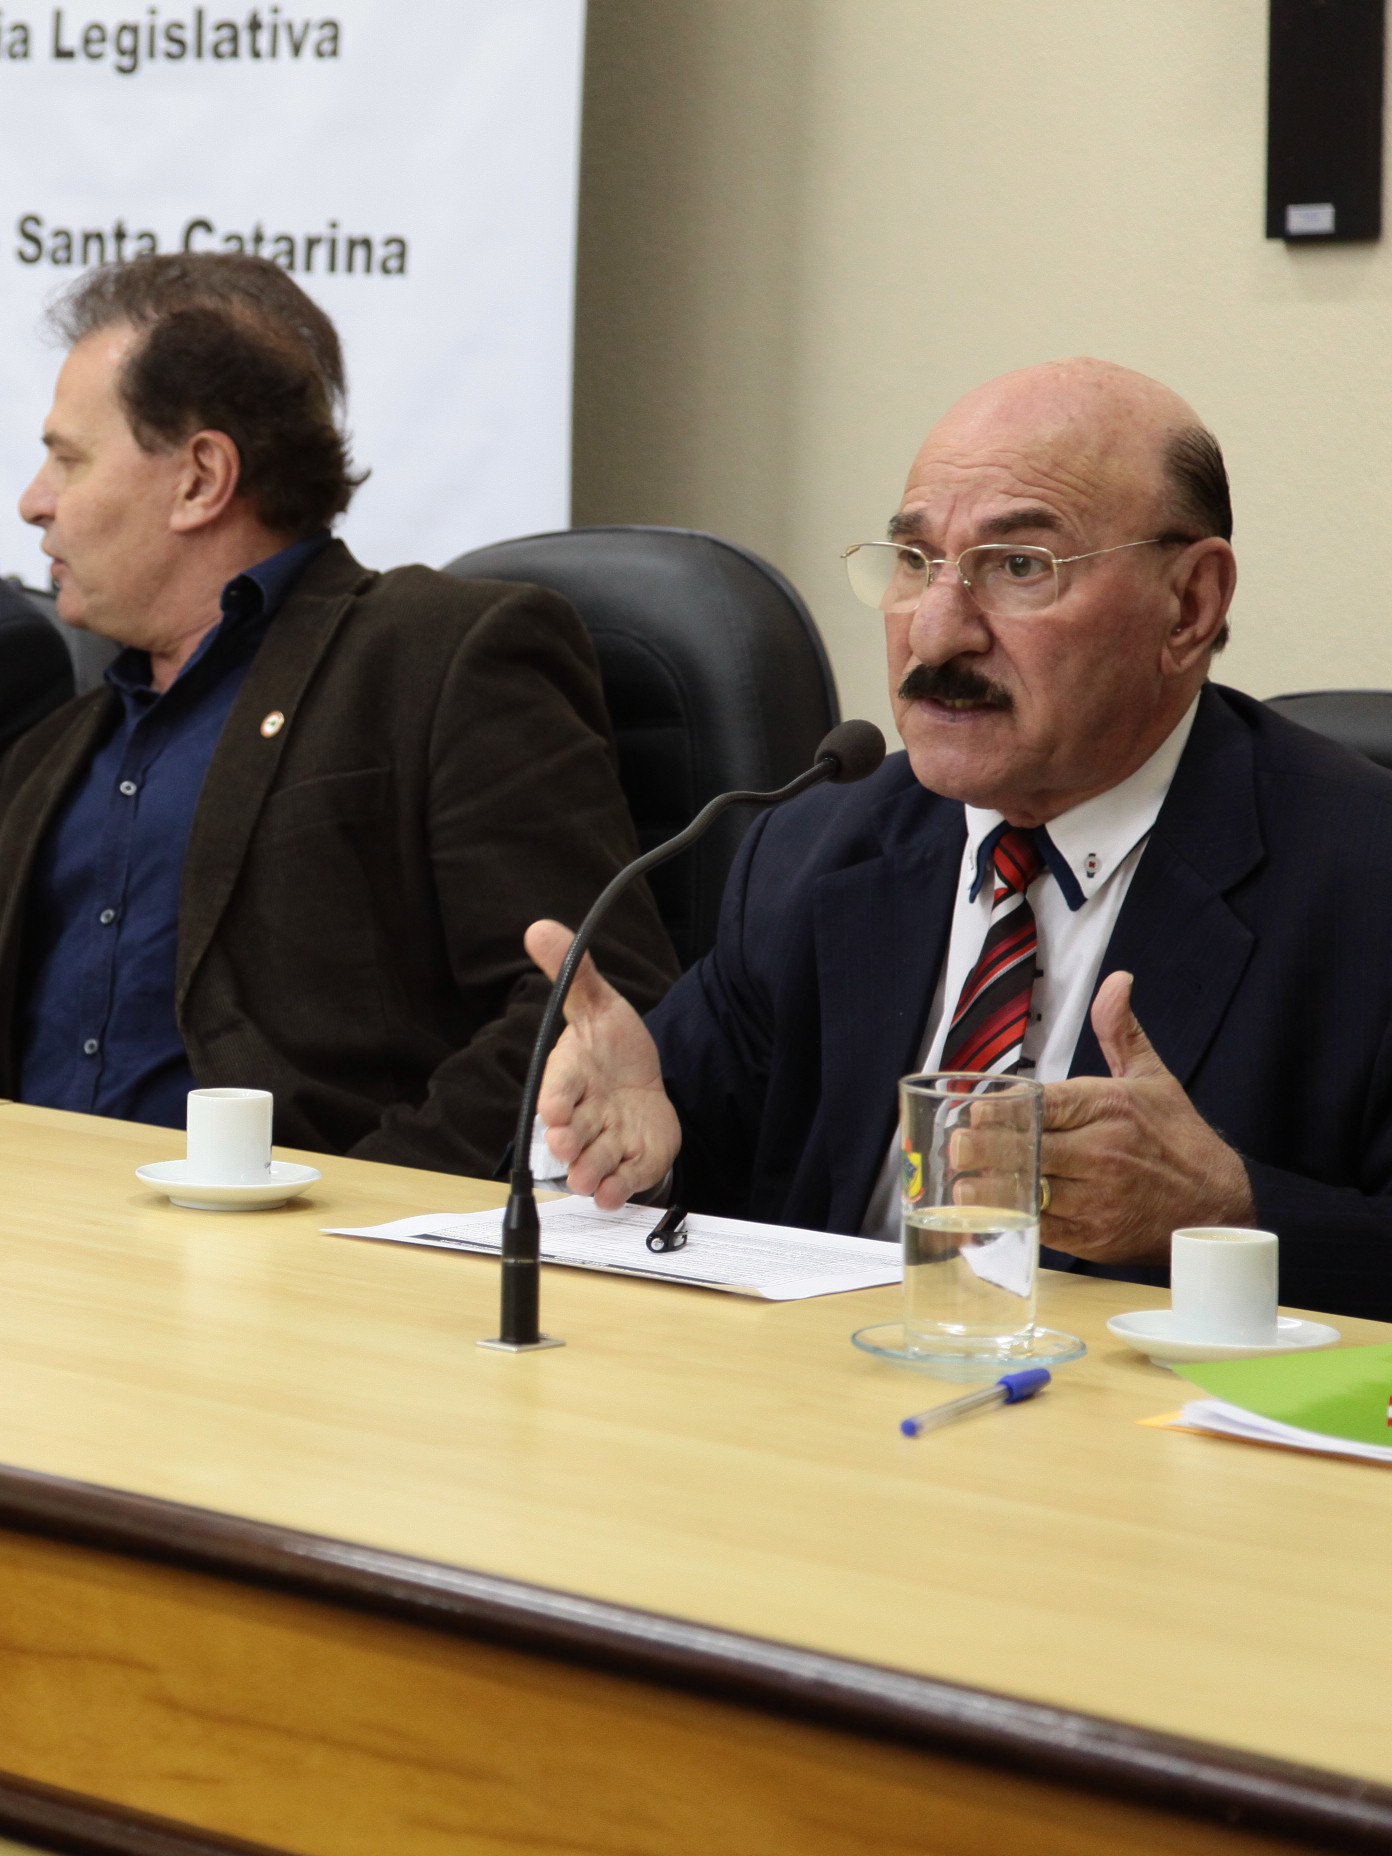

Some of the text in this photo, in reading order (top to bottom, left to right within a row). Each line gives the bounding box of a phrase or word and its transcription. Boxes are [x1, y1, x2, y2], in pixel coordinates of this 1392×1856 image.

[52, 8, 341, 75] Legislativa
[16, 214, 158, 266] Santa
[182, 217, 408, 275] Catarina
